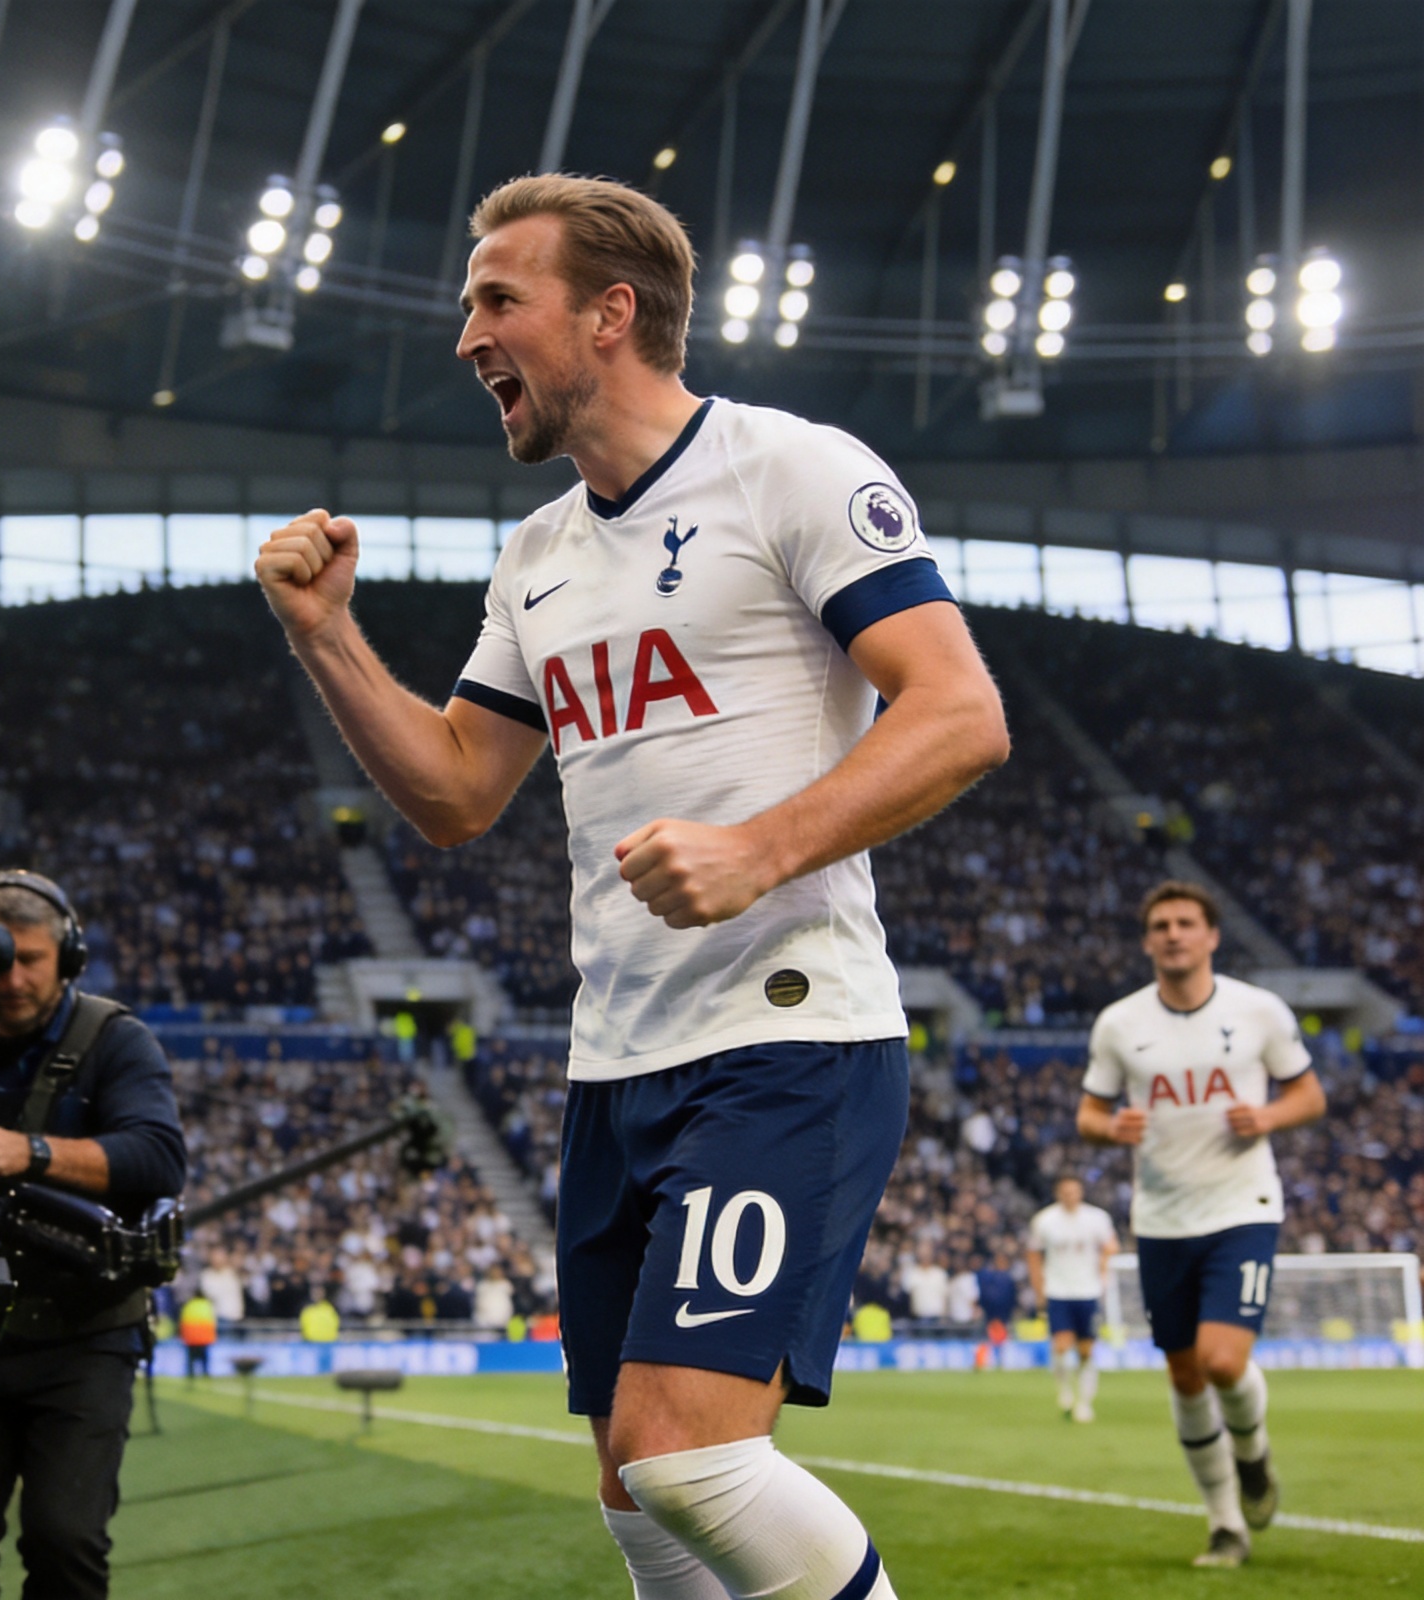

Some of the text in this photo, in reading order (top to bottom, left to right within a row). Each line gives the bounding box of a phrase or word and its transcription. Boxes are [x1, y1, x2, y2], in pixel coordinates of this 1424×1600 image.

[543, 627, 720, 756] AIA
[1148, 1066, 1237, 1111] AIA
[673, 1185, 787, 1297] 10
